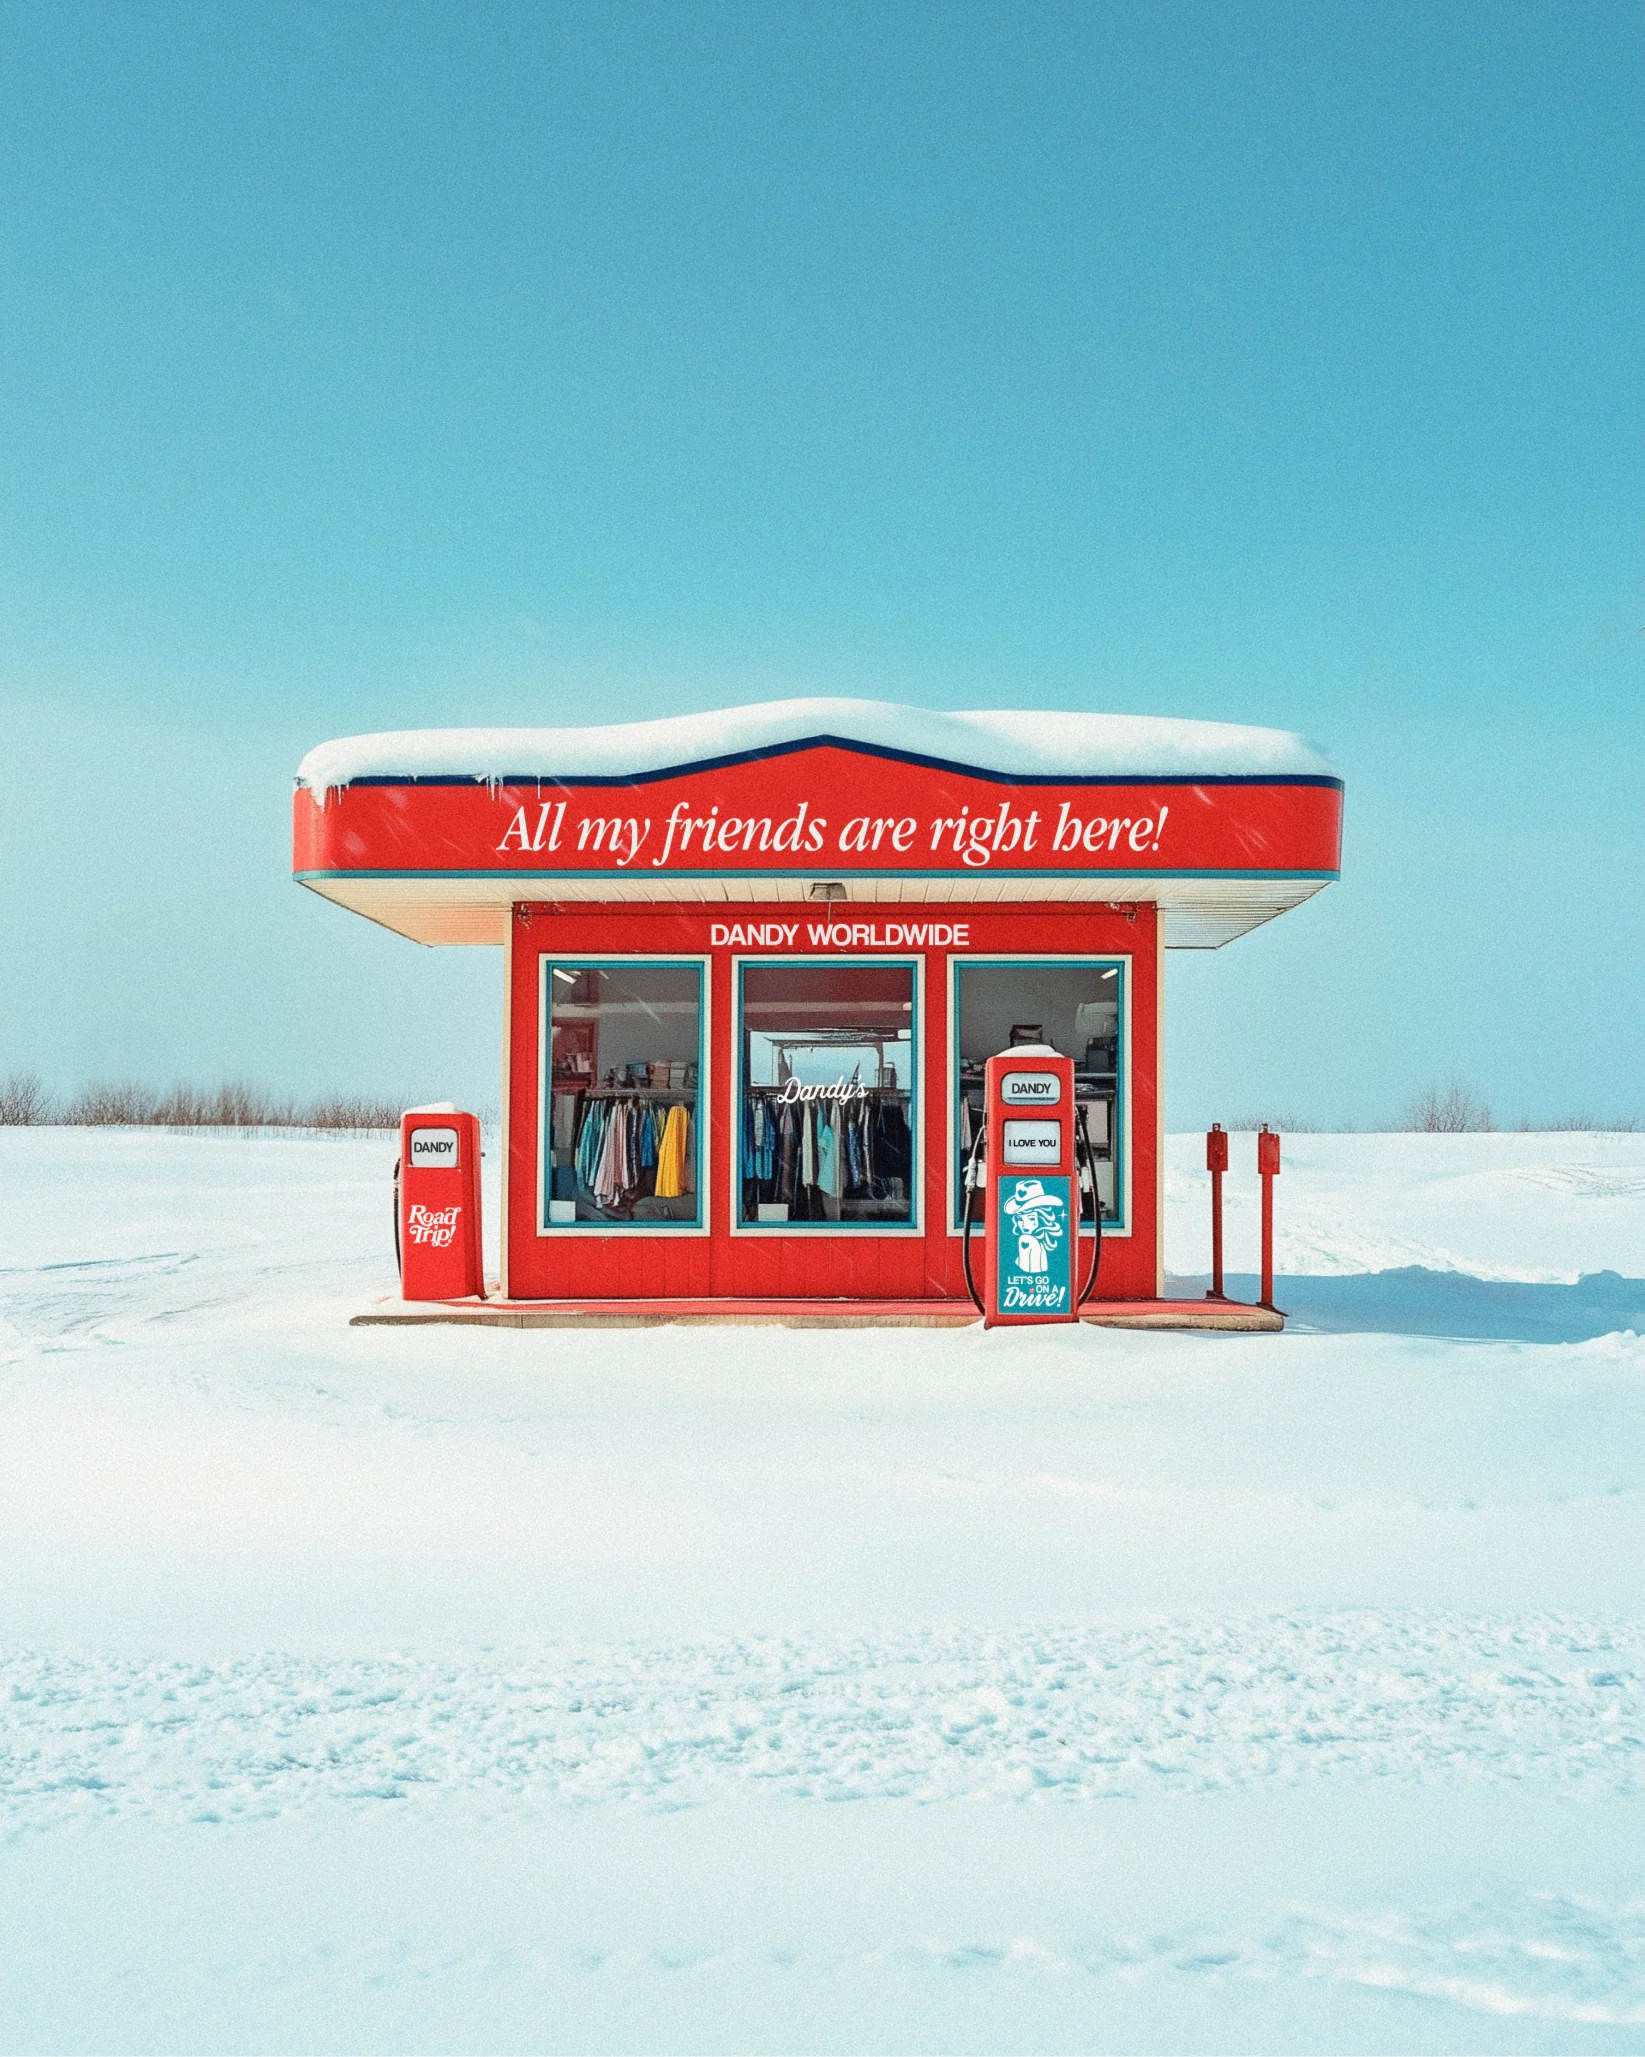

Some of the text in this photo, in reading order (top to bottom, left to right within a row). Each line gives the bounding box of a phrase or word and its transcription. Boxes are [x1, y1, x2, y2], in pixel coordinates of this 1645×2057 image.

[496, 801, 1169, 866] All my friends are right here!
[711, 924, 970, 946] DANDY WORLDWIDE
[777, 1074, 869, 1106] Dandy's
[1011, 1083, 1052, 1095] DANDY
[413, 1141, 453, 1153] DANDY
[408, 1204, 461, 1227] Road
[409, 1224, 457, 1247] Trip!
[1007, 1275, 1050, 1285] LET'S GO
[1035, 1285, 1059, 1293] ON A
[1003, 1286, 1066, 1307] Drive!
